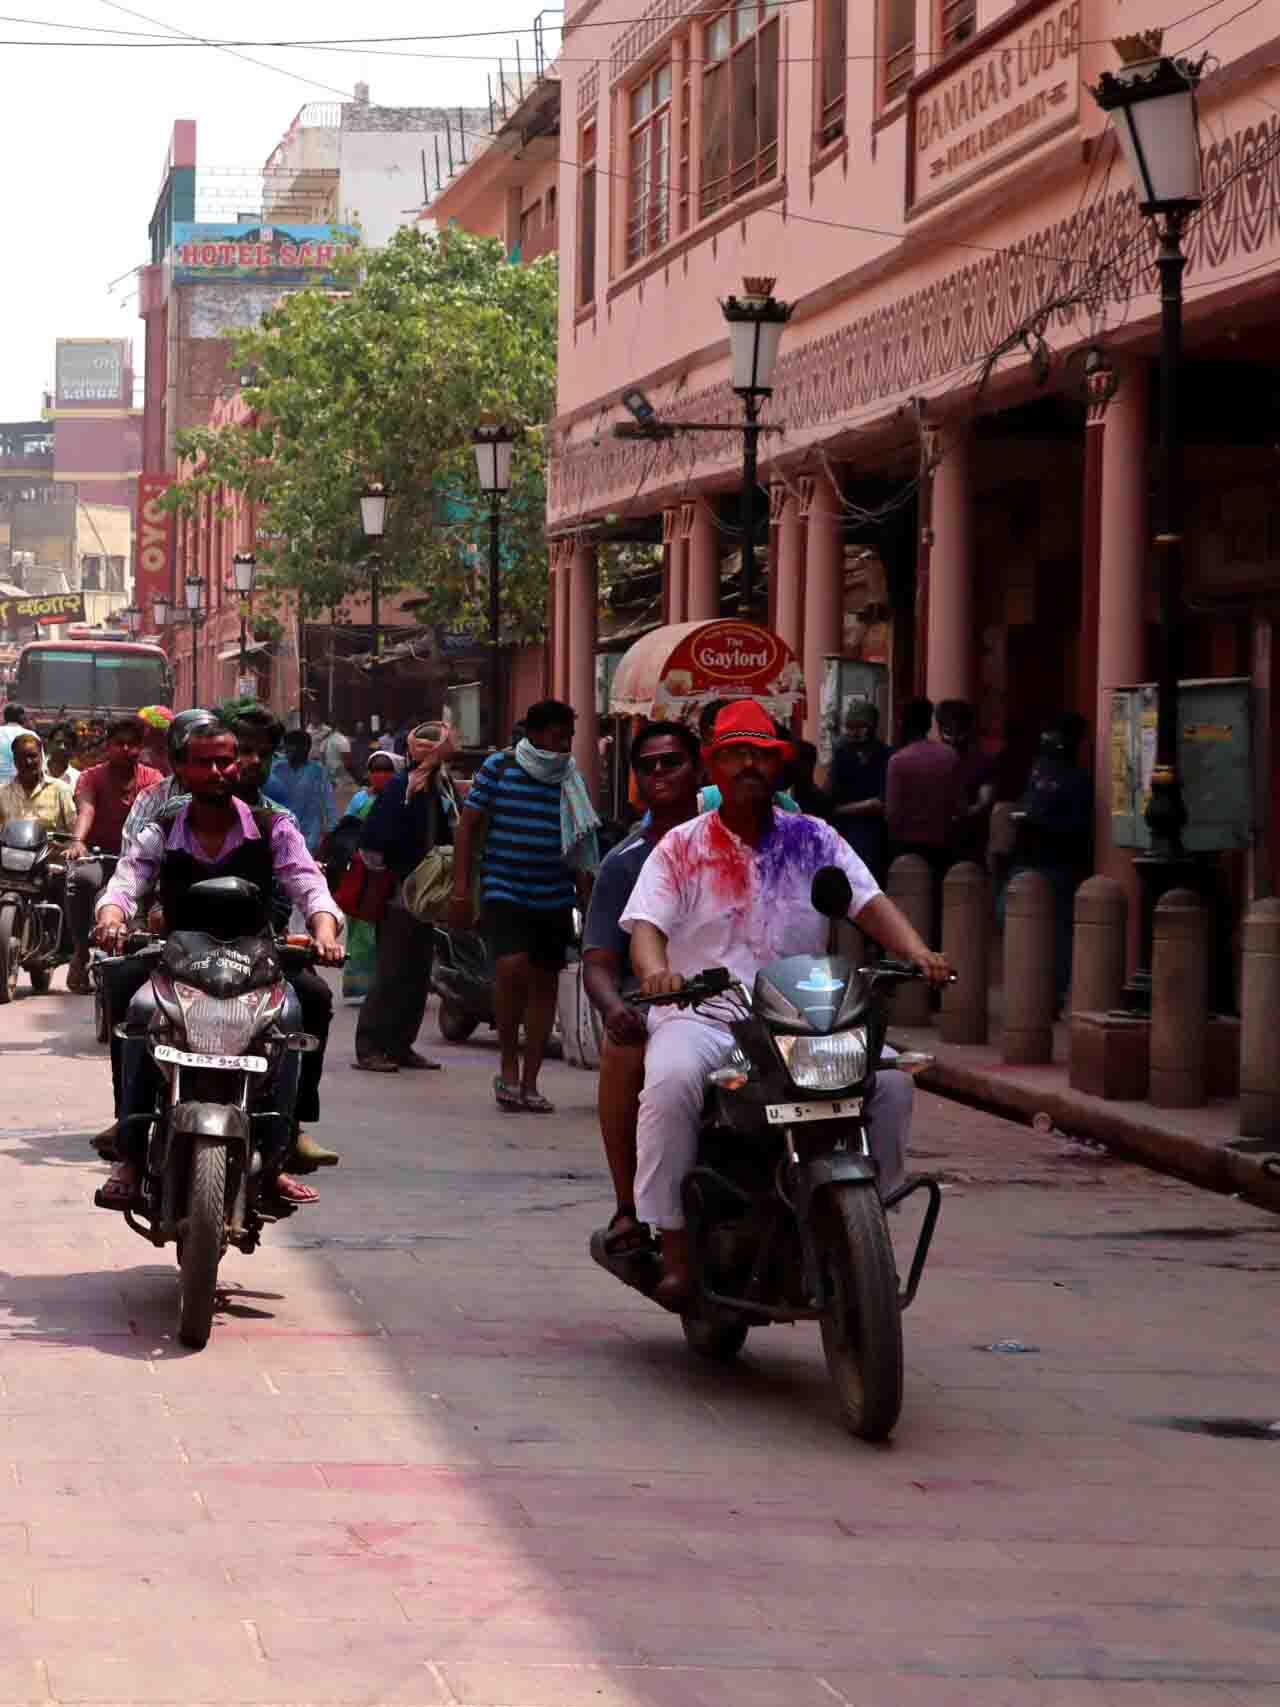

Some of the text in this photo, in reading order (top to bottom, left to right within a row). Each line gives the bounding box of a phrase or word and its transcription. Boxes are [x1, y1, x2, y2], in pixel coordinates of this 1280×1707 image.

[917, 2, 1080, 153] BANARAS LODGE
[180, 242, 273, 265] HOTEL
[699, 648, 768, 670] Gaylord
